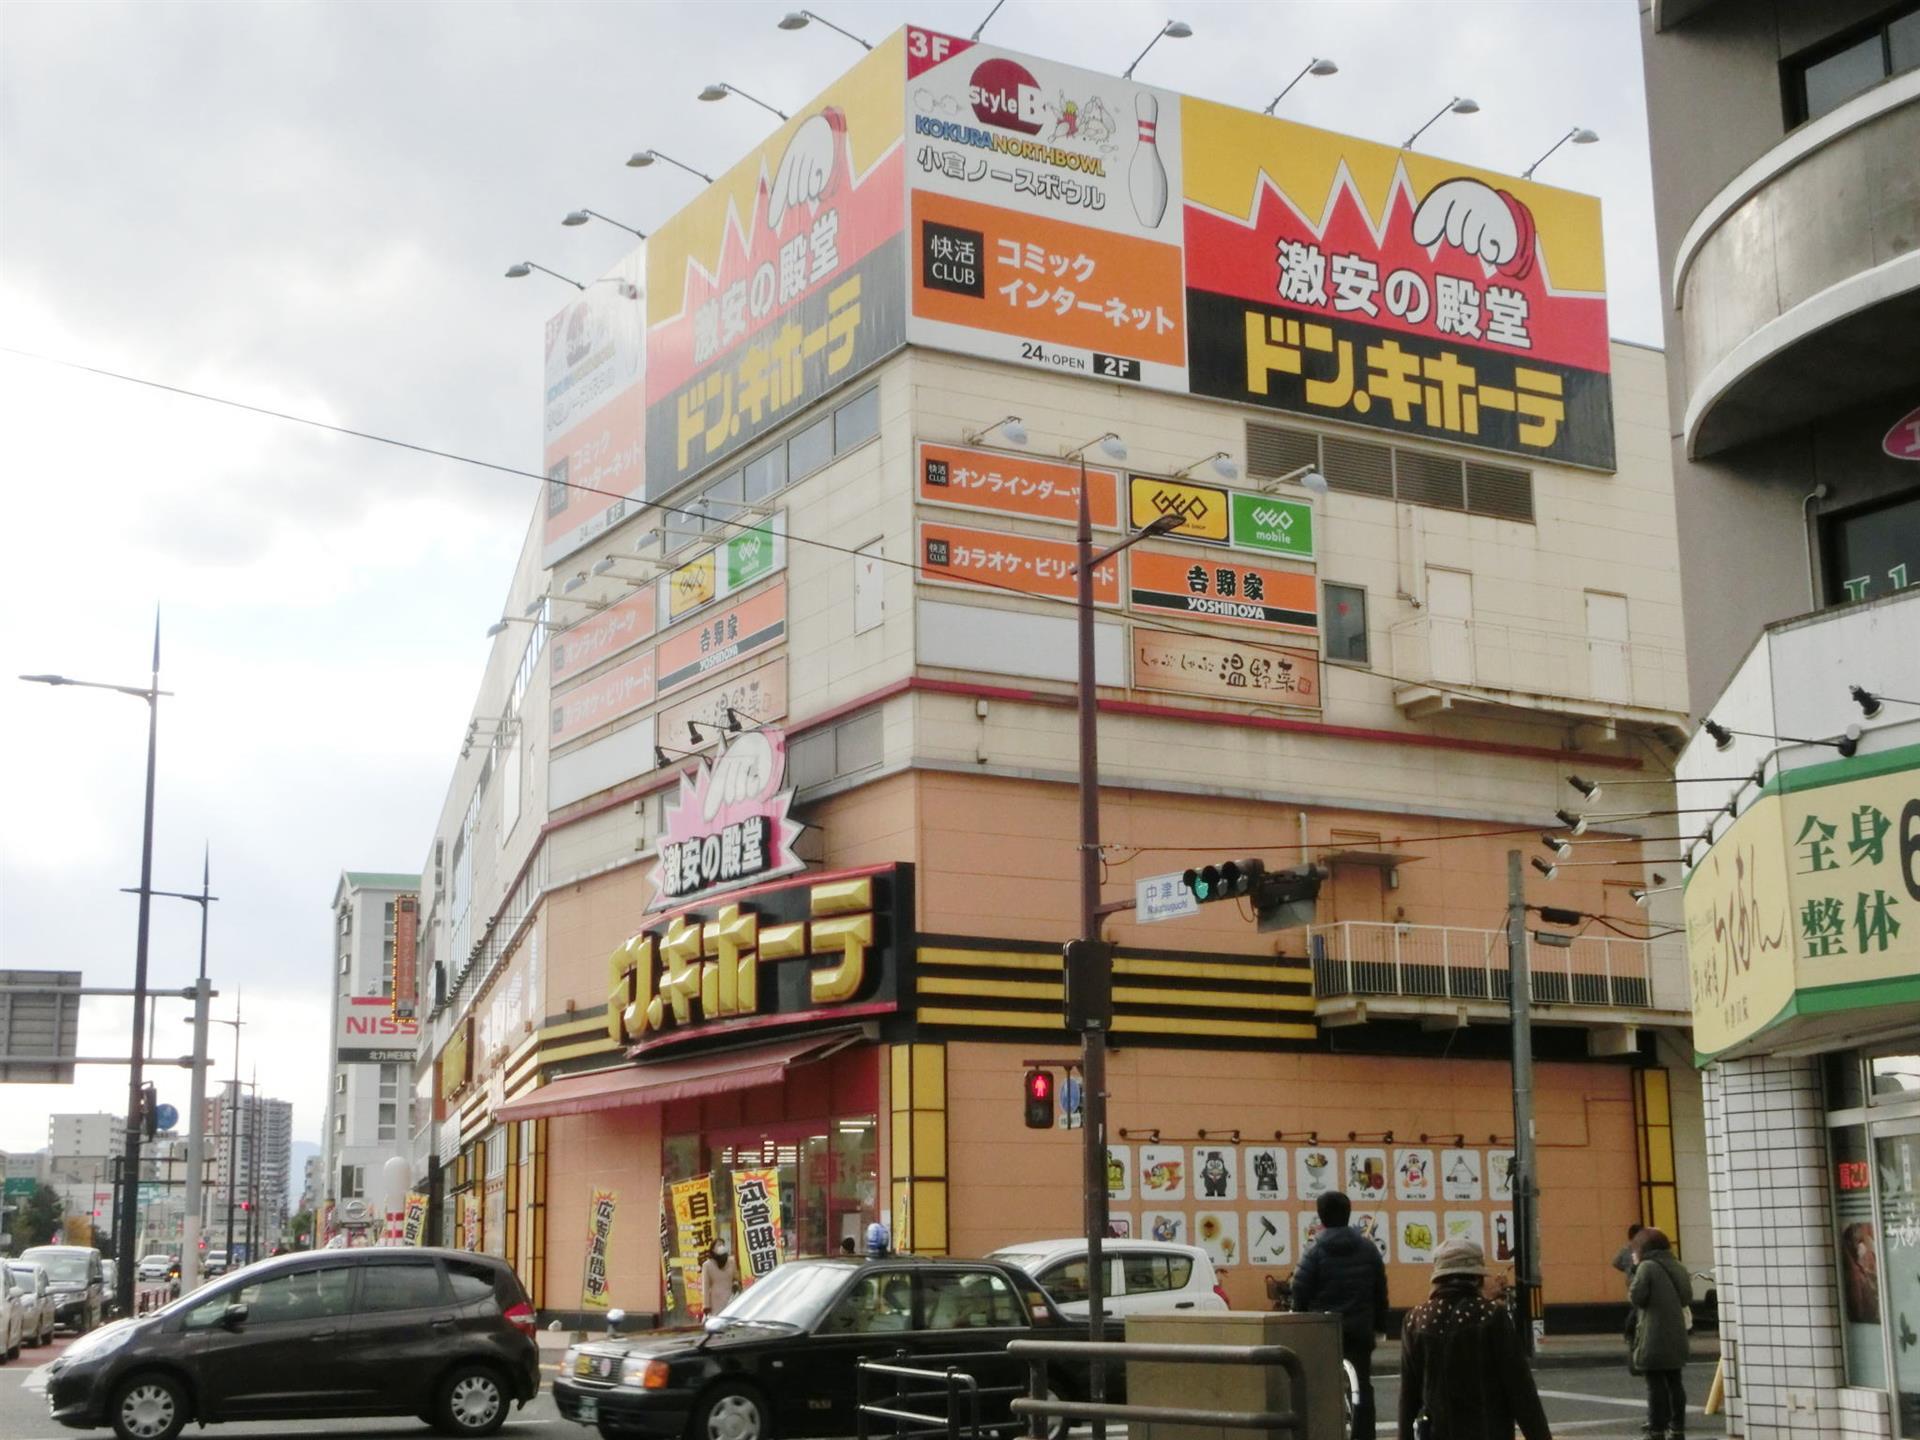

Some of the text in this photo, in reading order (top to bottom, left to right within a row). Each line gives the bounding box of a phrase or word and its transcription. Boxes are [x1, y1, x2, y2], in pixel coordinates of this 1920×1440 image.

[908, 31, 950, 62] 3F
[917, 146, 1106, 210] 小倉ノースボウル
[930, 234, 976, 265] 快活
[931, 262, 976, 286] CLUB
[997, 238, 1096, 283] コミック
[693, 207, 840, 364] 激安の殿堂
[998, 278, 1175, 336] インターネット
[1276, 238, 1533, 350] 激安の殿堂
[1052, 354, 1085, 370] OPEN
[1103, 356, 1130, 377] 2F
[1256, 530, 1292, 545] mobile
[1187, 565, 1265, 600] 吉野家
[663, 816, 768, 898] 激安の殿堂
[1794, 805, 1891, 875] 全身
[1799, 889, 1901, 960] 整体
